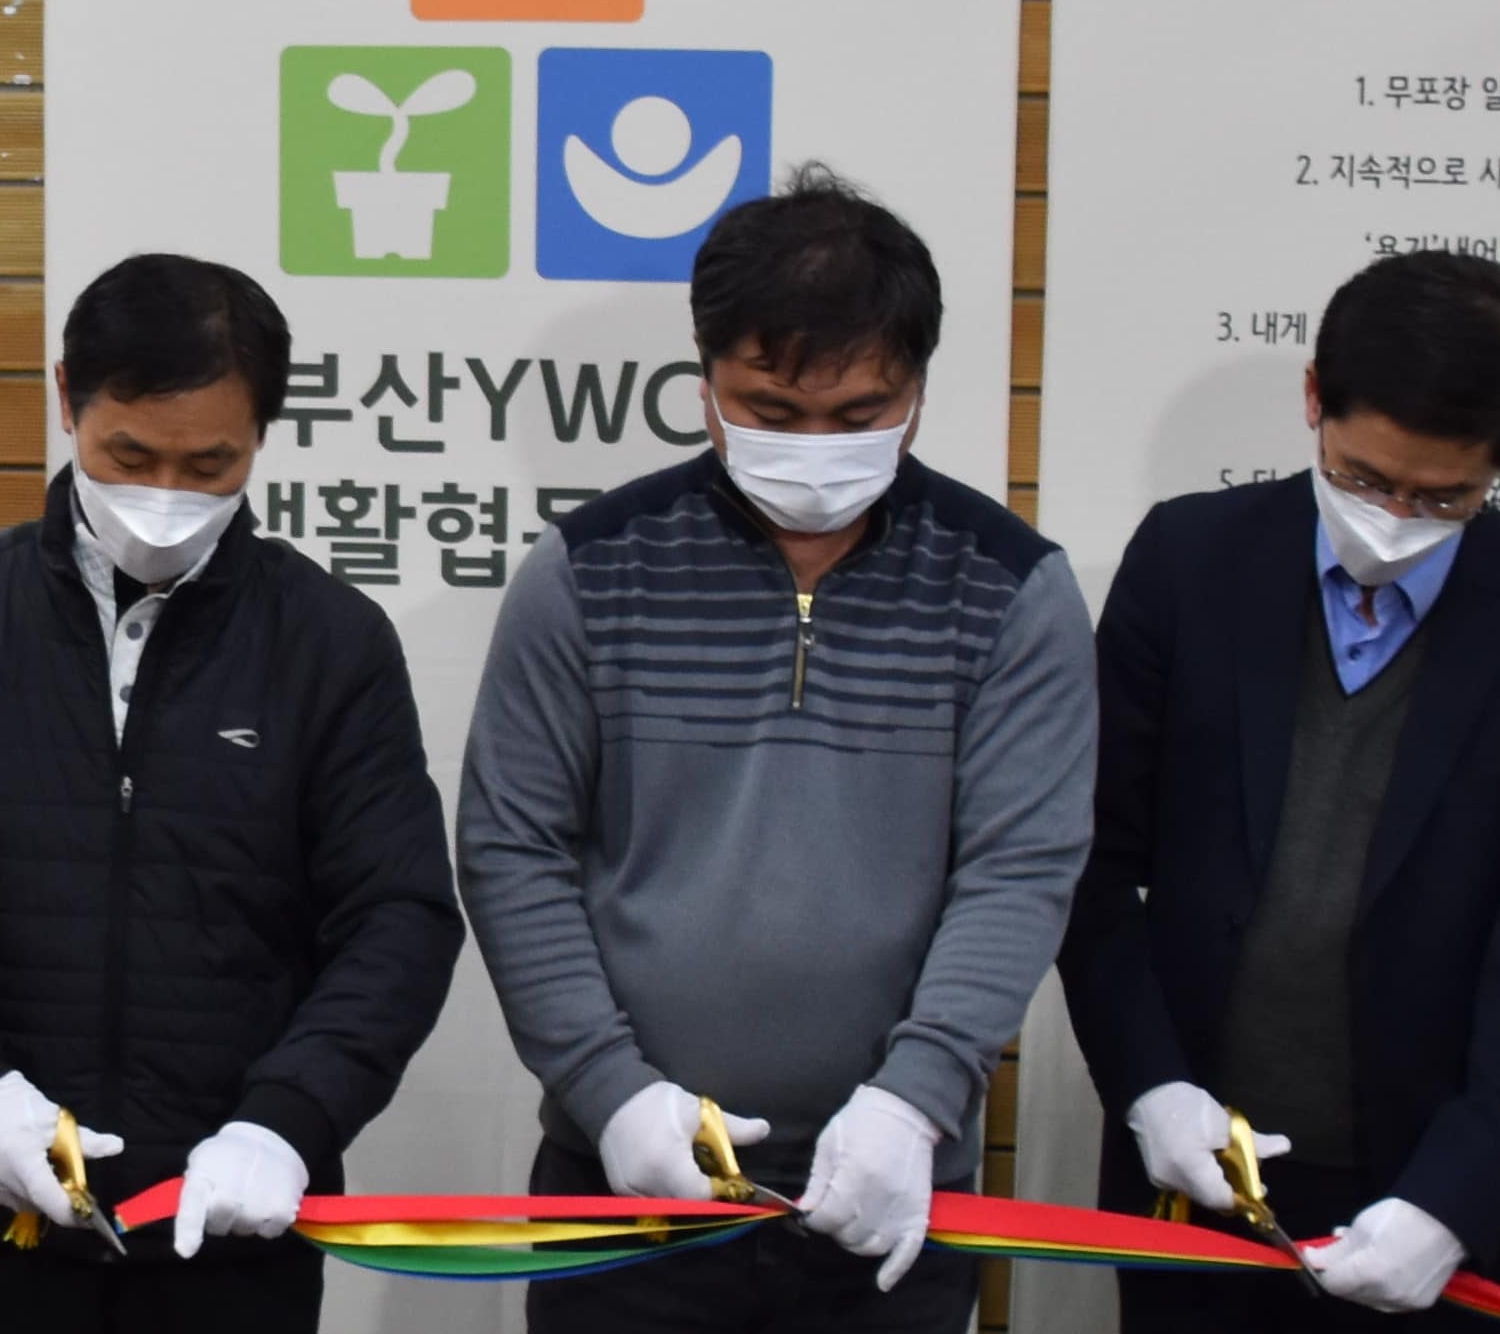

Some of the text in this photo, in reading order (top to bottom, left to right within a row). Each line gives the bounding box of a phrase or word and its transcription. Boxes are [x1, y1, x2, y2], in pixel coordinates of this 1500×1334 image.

[1357, 78, 1376, 107] 1.
[1385, 77, 1471, 112] 무포장
[1295, 155, 1319, 186] 2.
[1330, 154, 1469, 190] 지속적으로
[1216, 312, 1241, 342] 3.
[1251, 312, 1307, 345] 내게
[278, 350, 709, 454] 부산YWC
